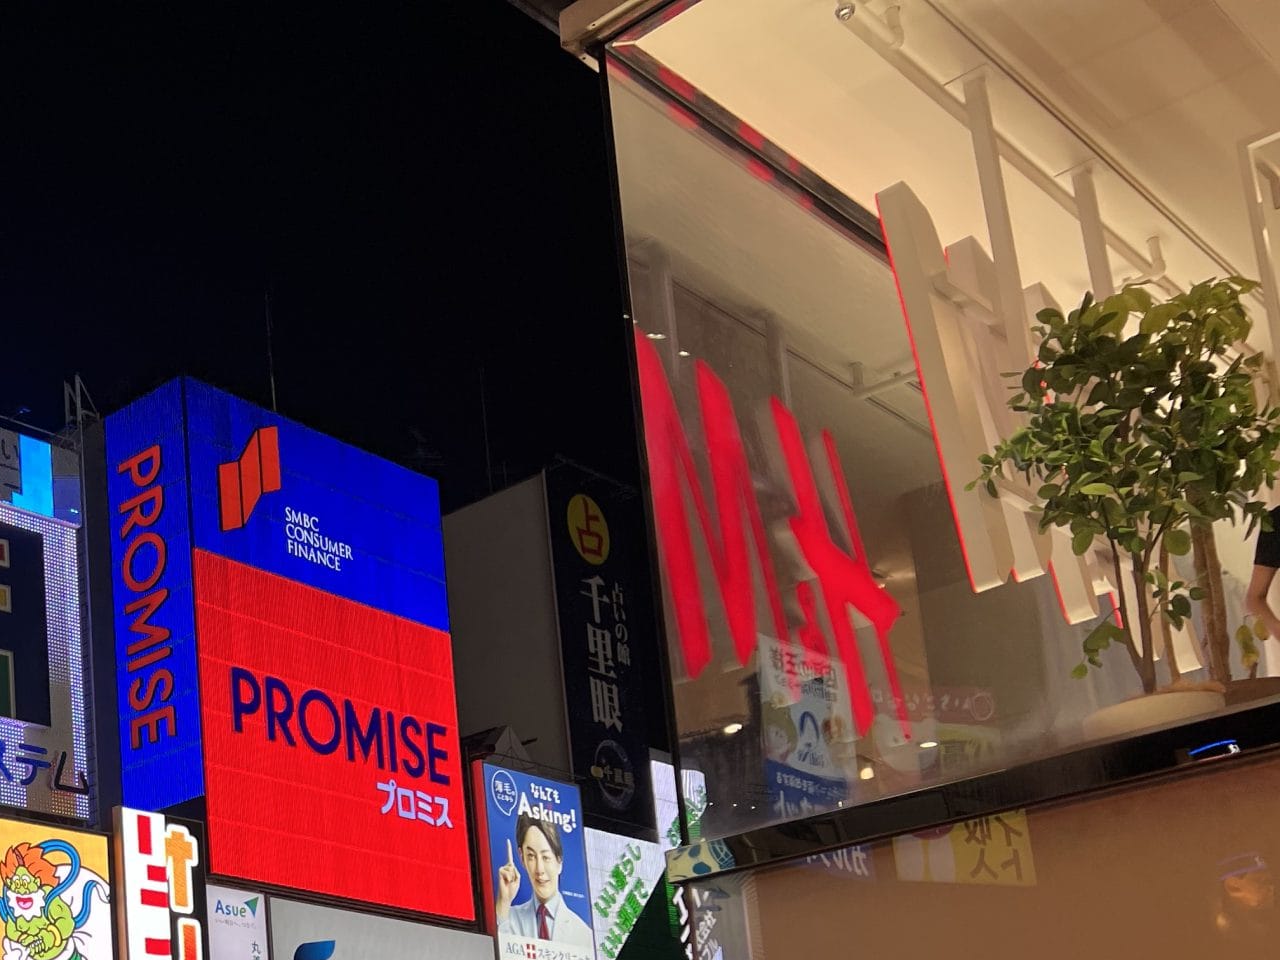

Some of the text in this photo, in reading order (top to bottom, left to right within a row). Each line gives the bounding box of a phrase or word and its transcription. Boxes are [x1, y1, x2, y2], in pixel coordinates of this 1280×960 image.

[285, 506, 319, 531] SMBC
[575, 498, 603, 558] 占
[286, 523, 353, 560] CONSUMER
[288, 539, 341, 571] FINANCE
[117, 444, 177, 750] PROMISE
[580, 575, 623, 733] 千里眼
[230, 666, 450, 786] PROMISE
[377, 779, 454, 828] プロミス
[518, 791, 577, 833] Asking!
[530, 782, 561, 804] なんでも
[215, 899, 247, 917] Asue
[506, 942, 526, 956] AGA
